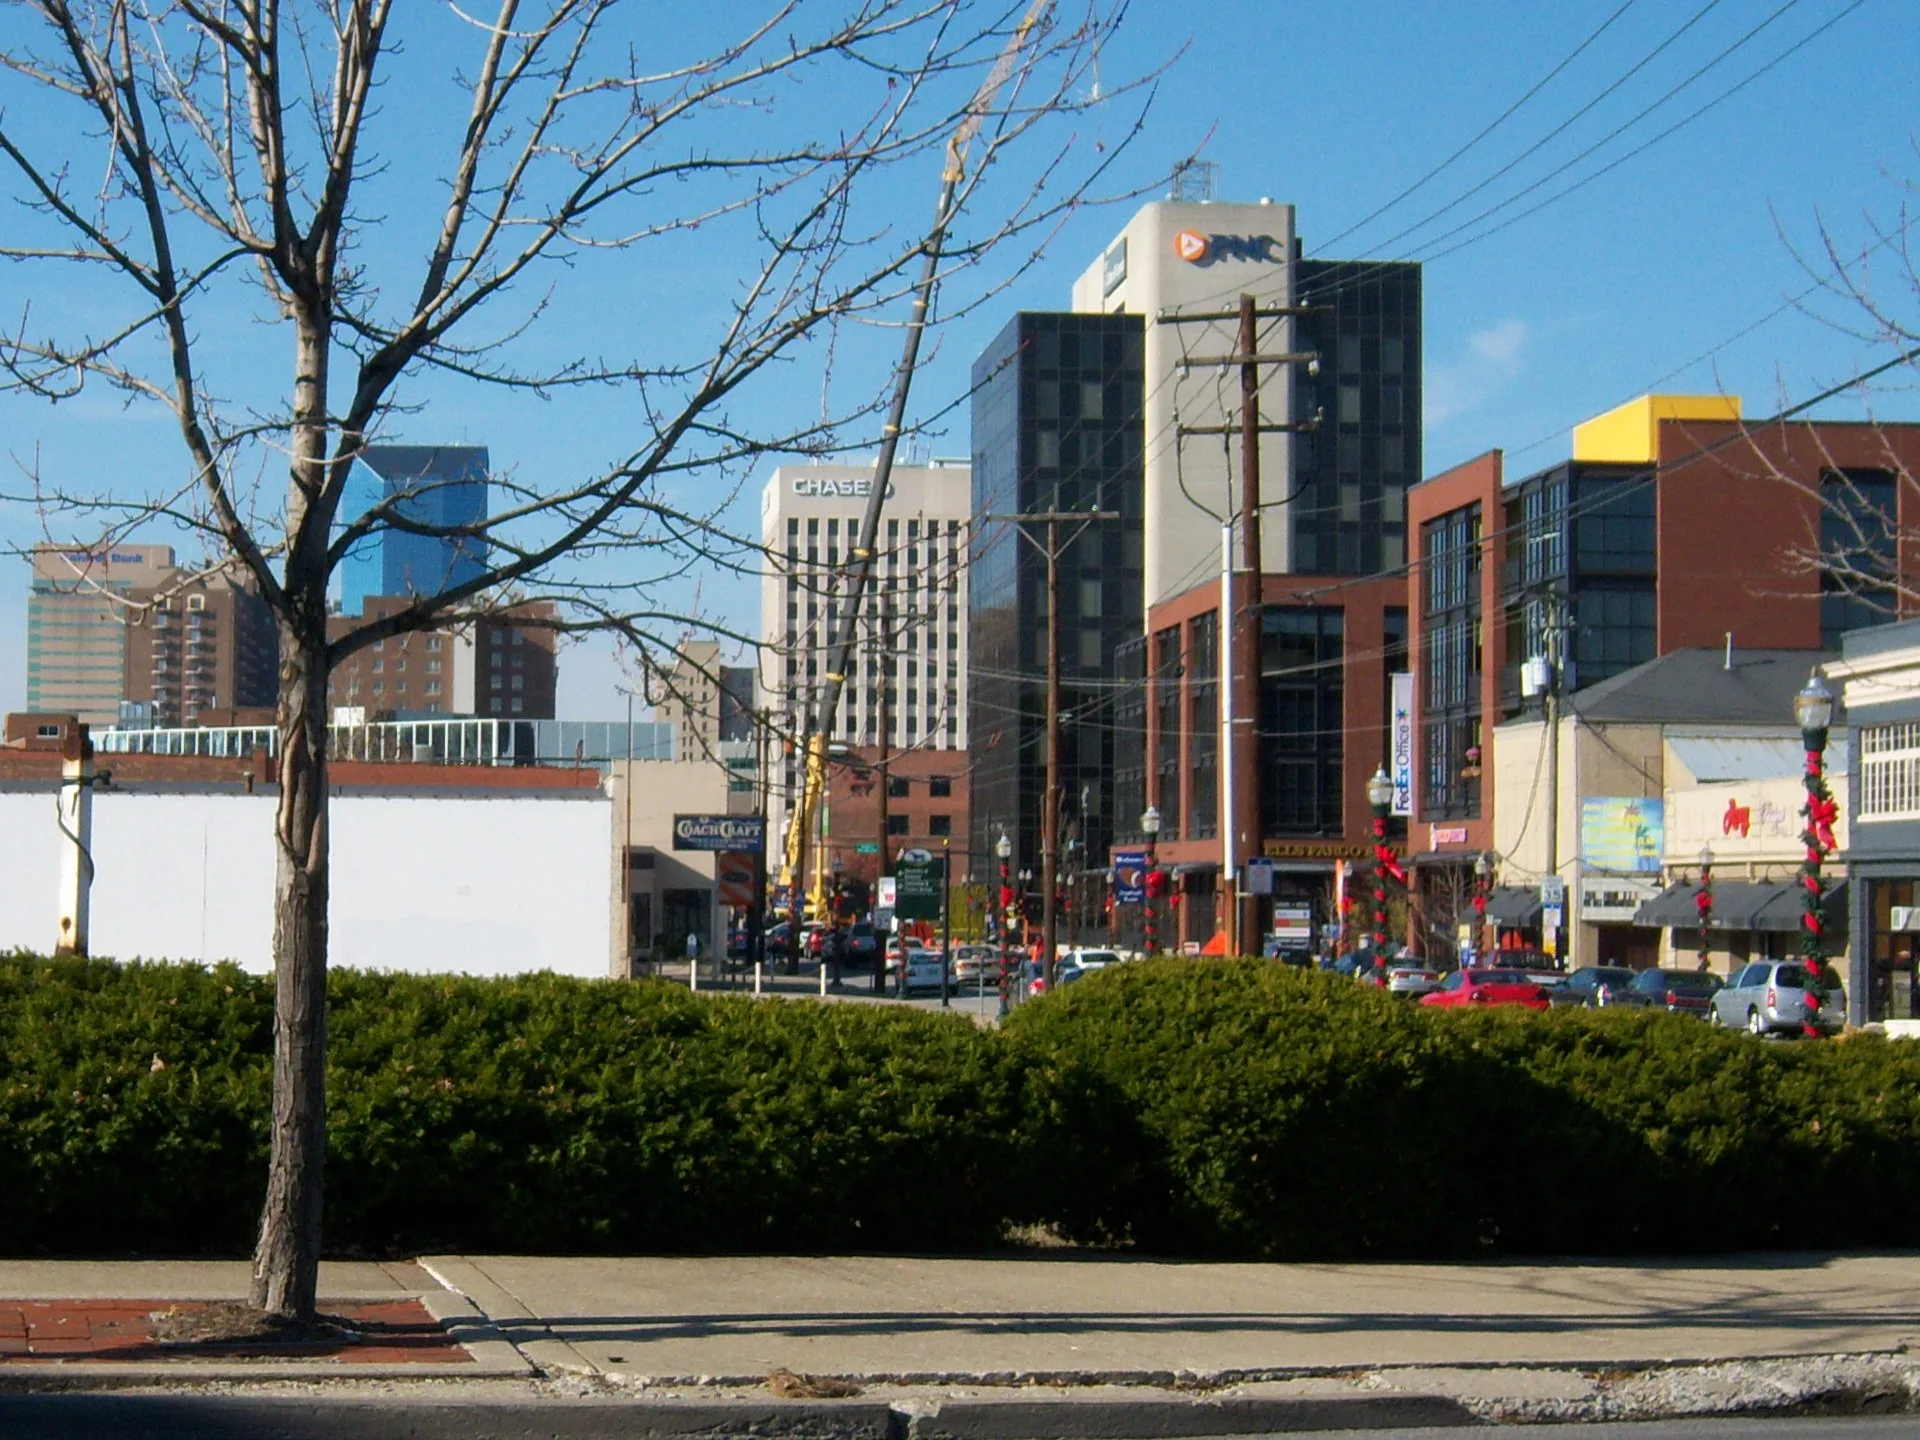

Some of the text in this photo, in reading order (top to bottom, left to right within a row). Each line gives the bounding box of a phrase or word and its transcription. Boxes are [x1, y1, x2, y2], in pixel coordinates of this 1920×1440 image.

[1209, 233, 1284, 264] PNC
[792, 479, 870, 496] CHASE
[1395, 724, 1409, 811] FedEx Office
[1264, 844, 1304, 857] ELLS
[1305, 844, 1361, 857] FARGO
